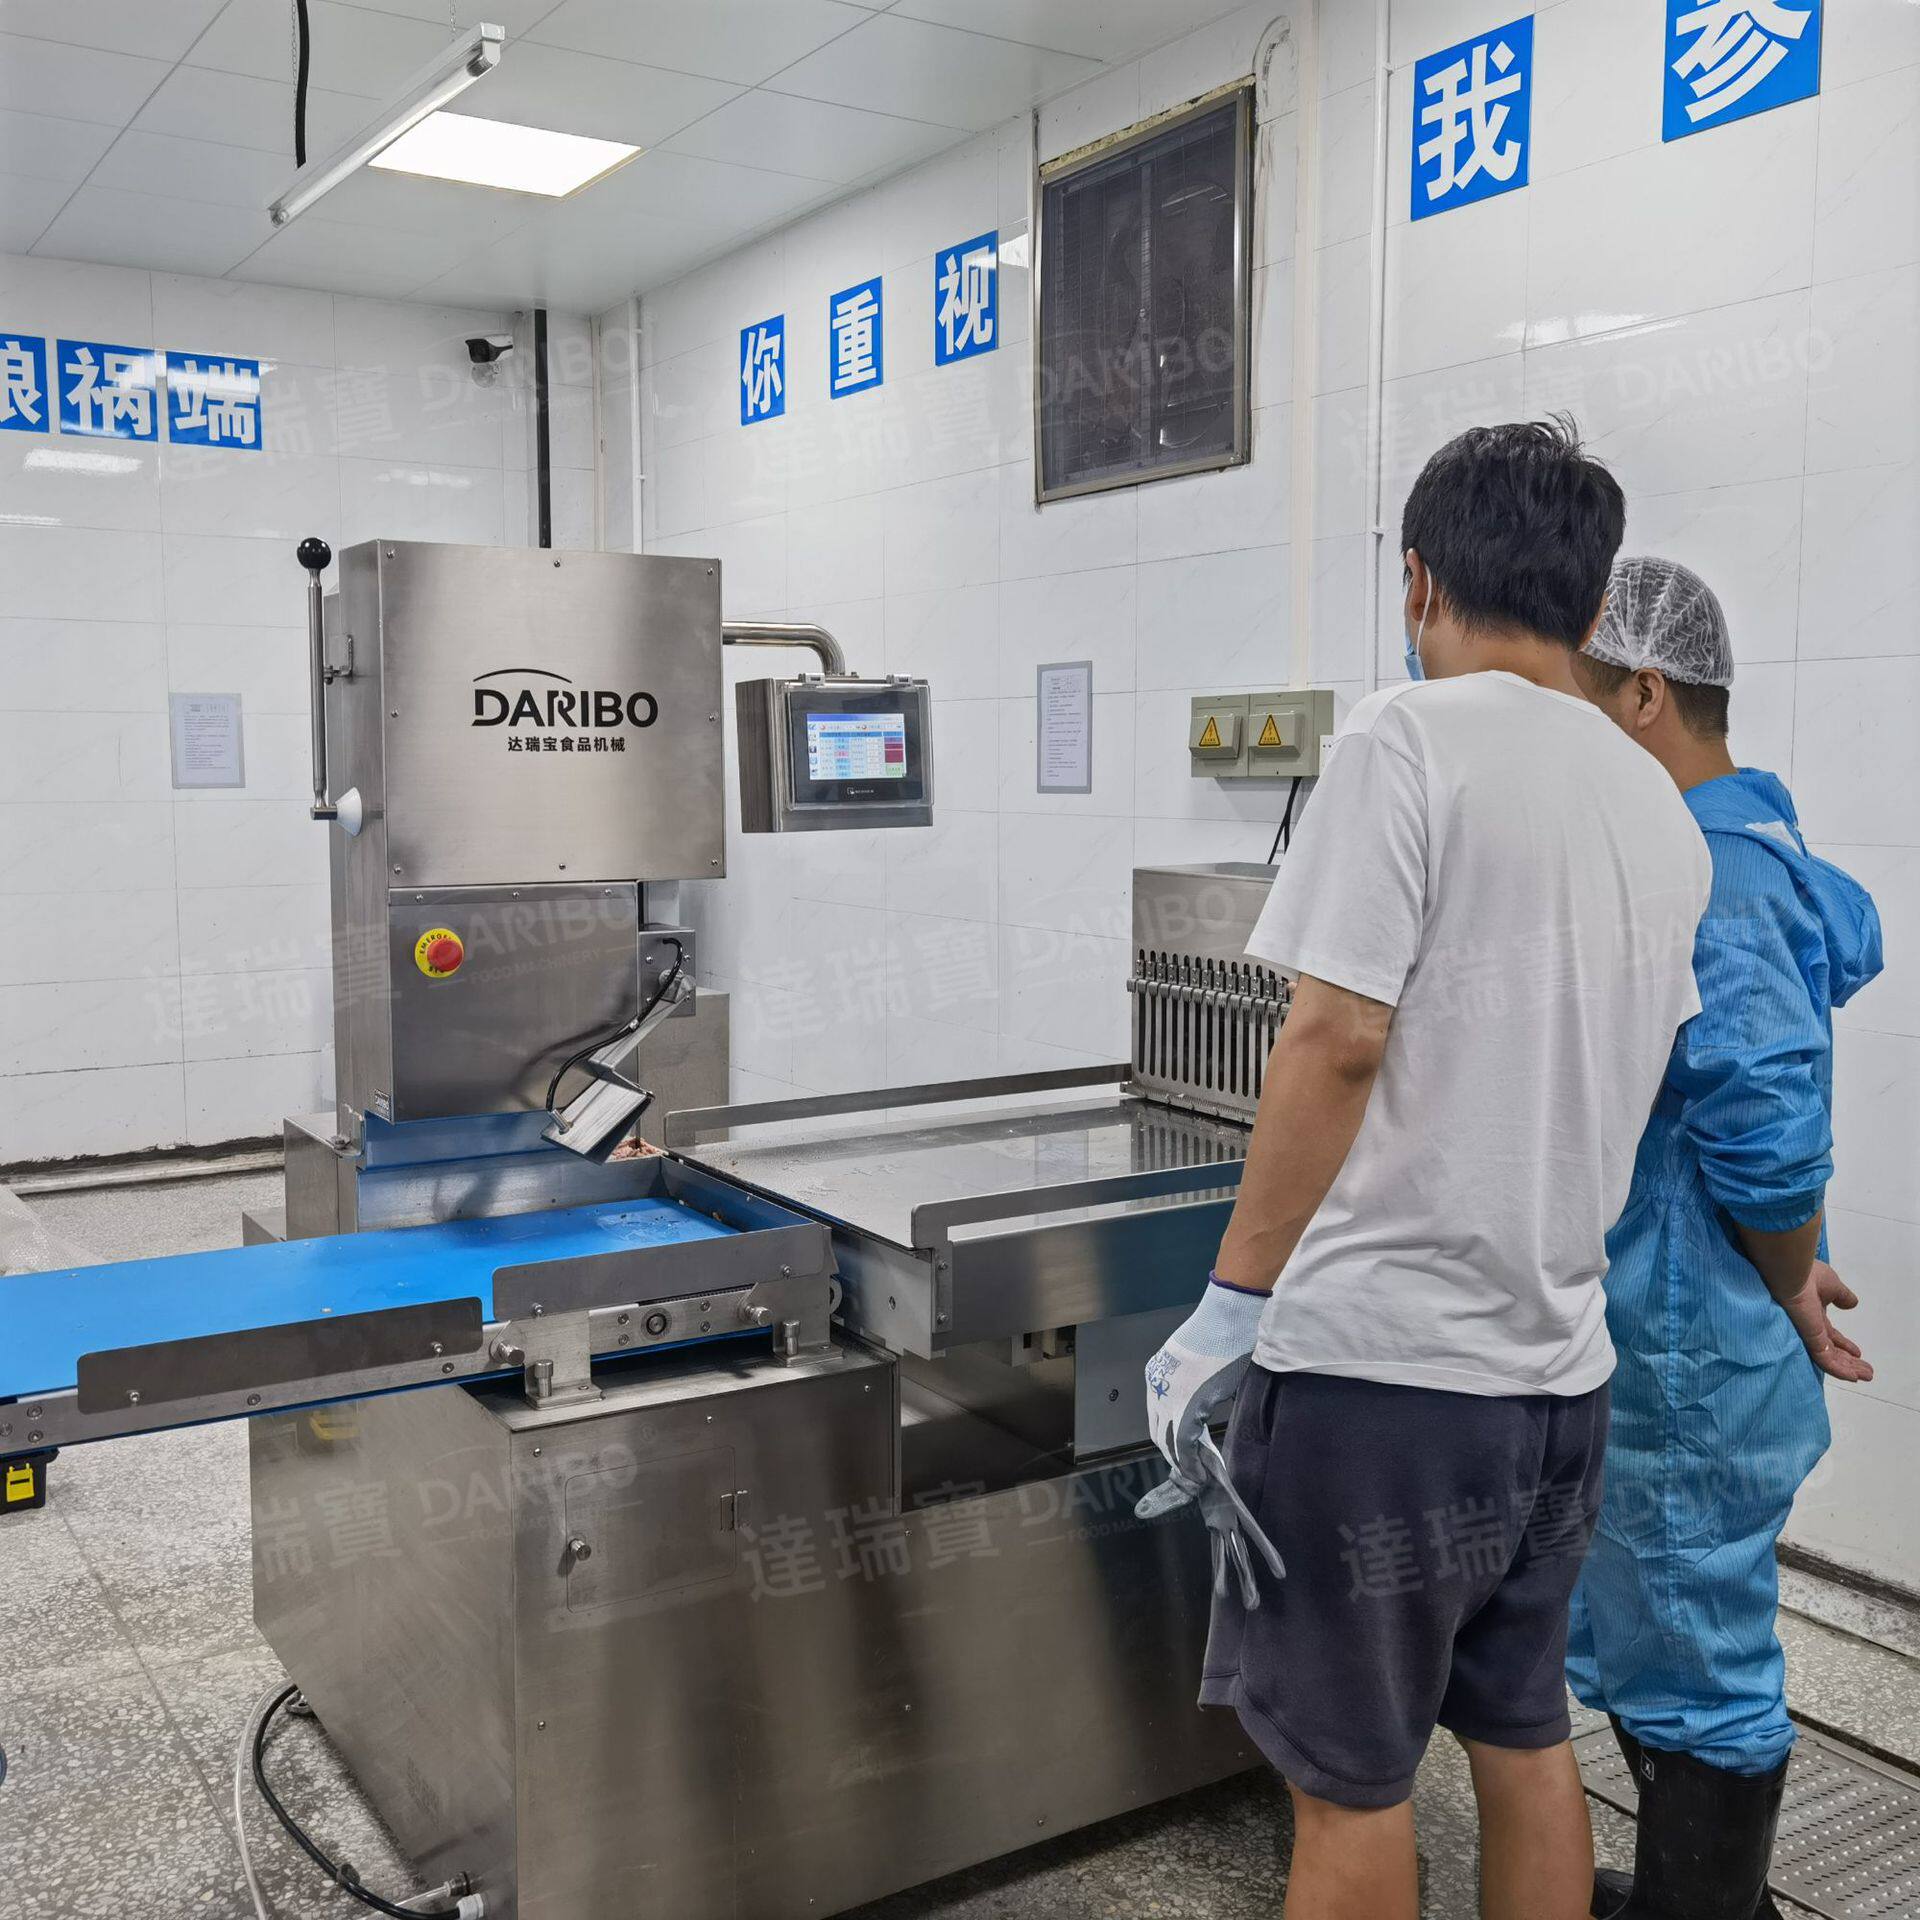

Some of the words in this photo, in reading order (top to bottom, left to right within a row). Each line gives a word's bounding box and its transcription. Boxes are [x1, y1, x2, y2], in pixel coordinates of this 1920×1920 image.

[471, 689, 659, 728] DARIBO
[508, 736, 626, 752] 达瑞宝食品机械
